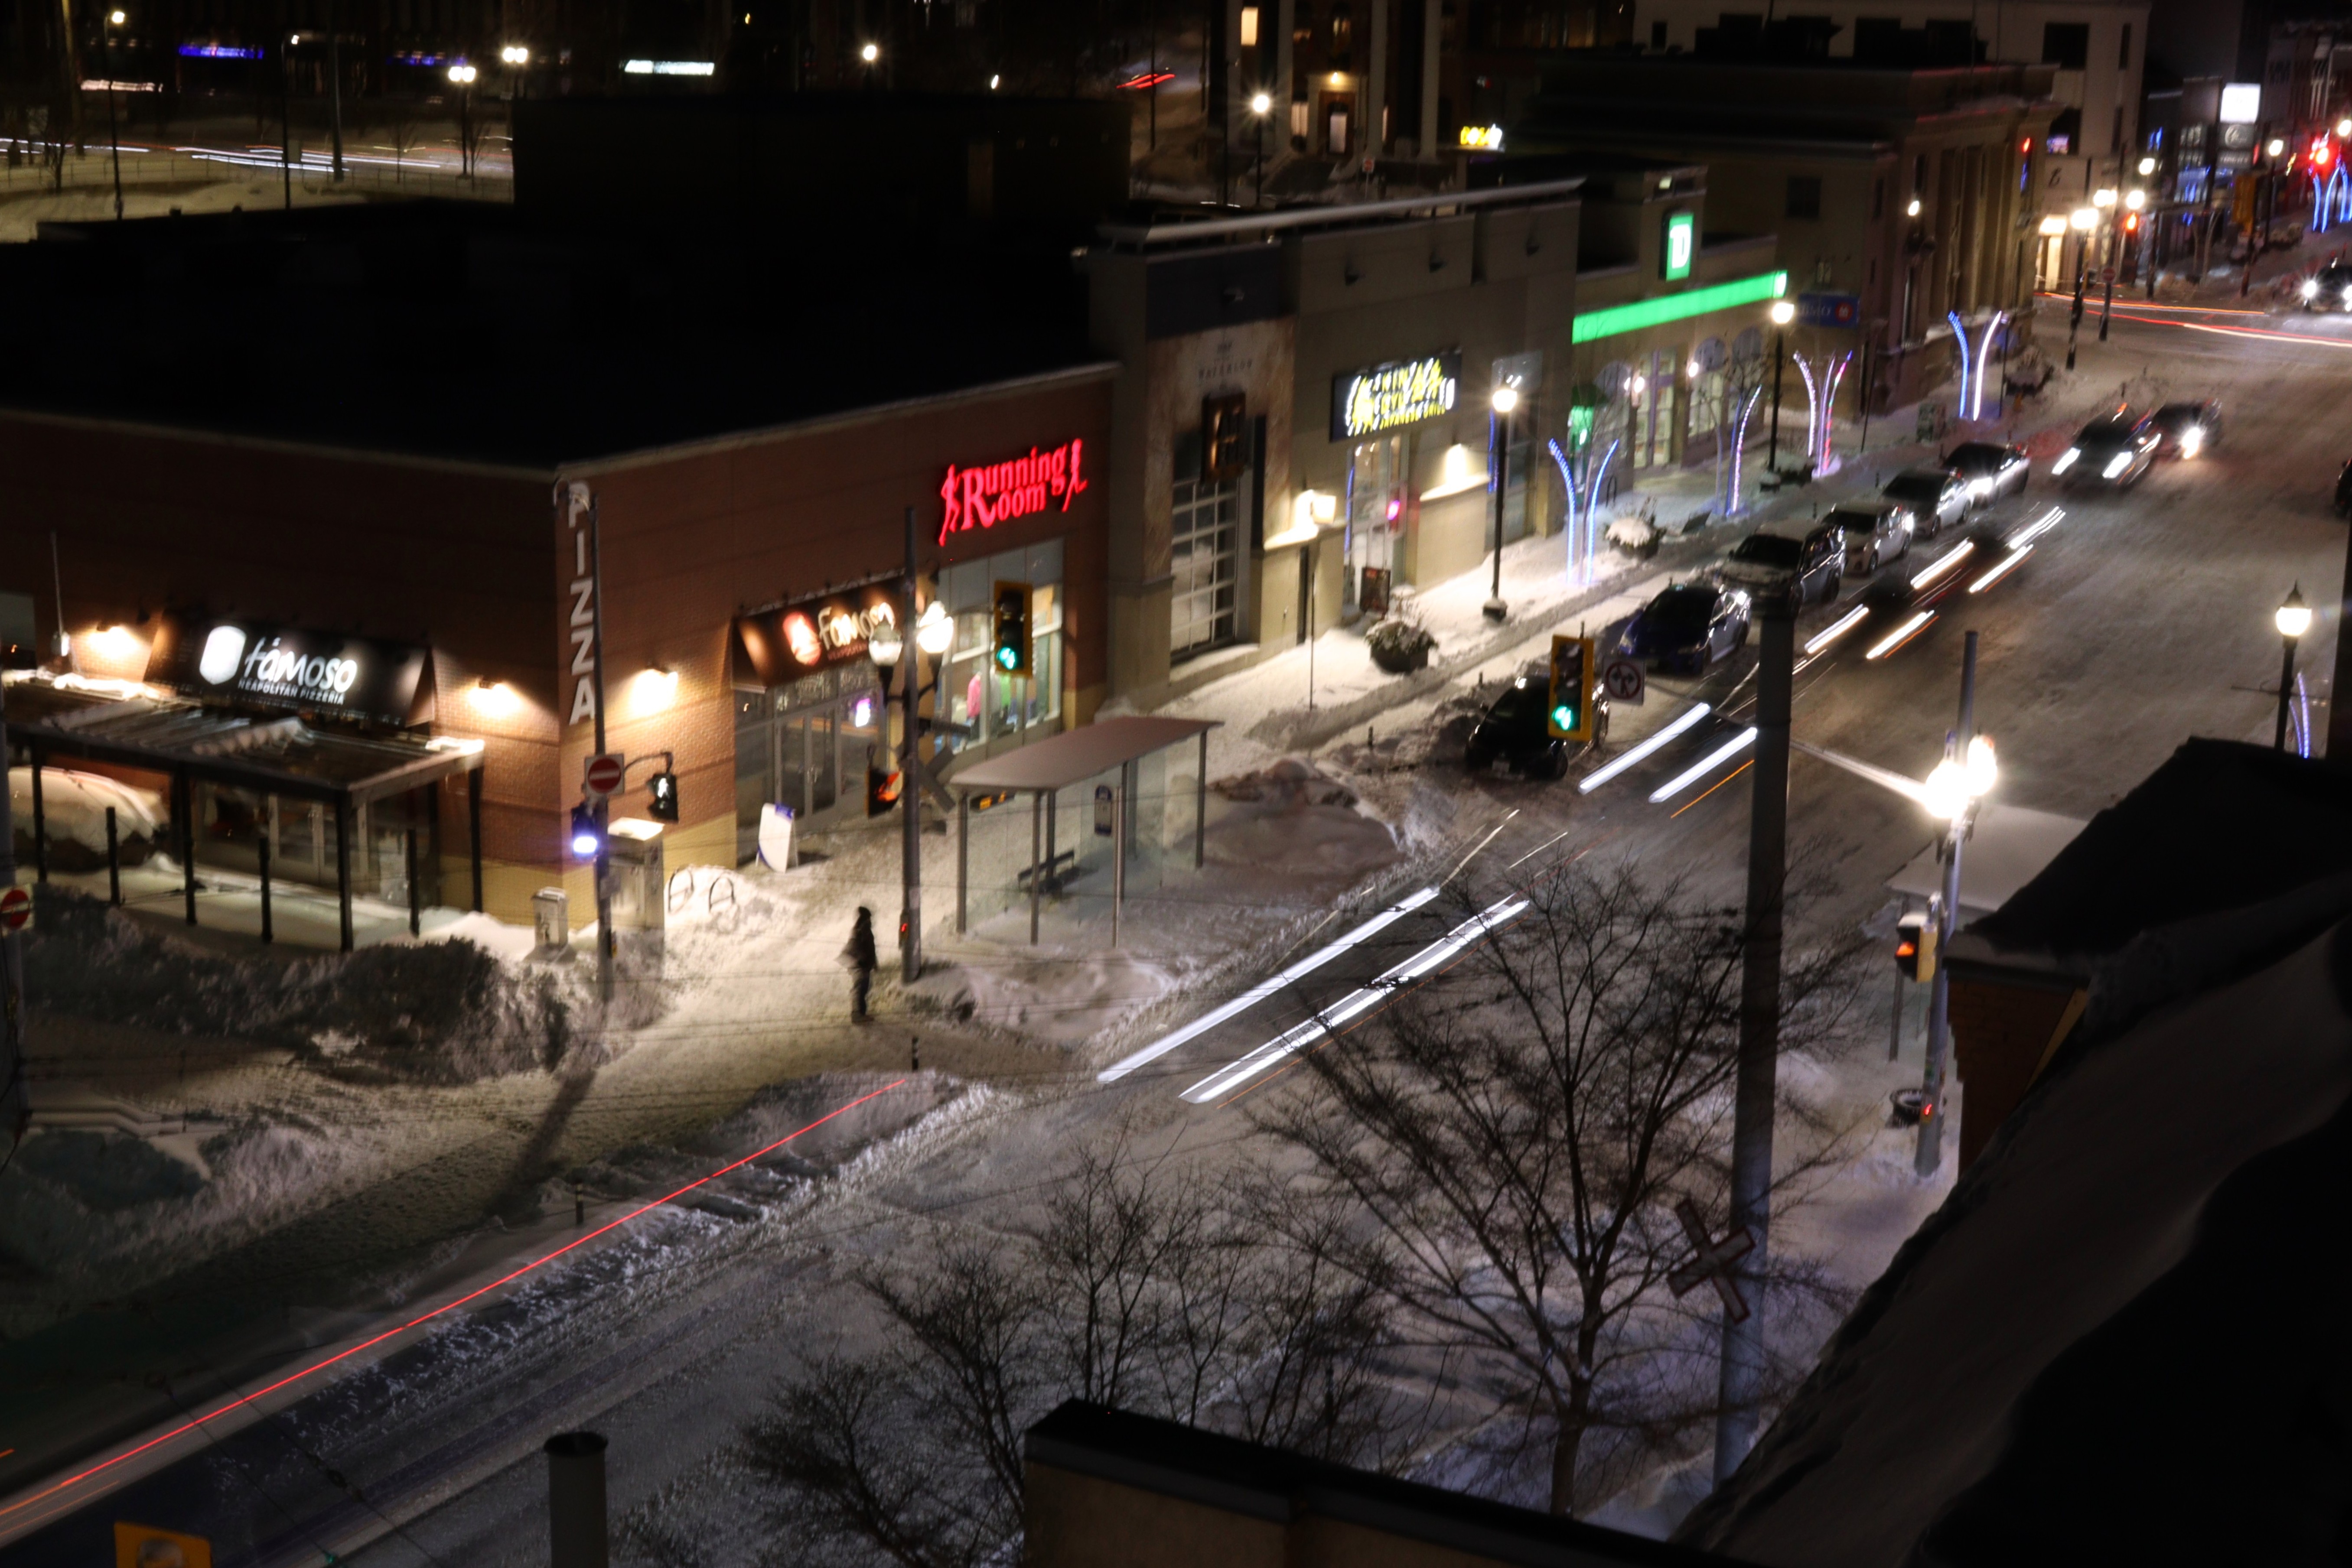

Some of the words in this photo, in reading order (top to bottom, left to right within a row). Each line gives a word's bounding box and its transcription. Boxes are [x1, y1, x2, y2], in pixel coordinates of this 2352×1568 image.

[961, 443, 1067, 530] Running
[568, 480, 596, 726] PIZZA
[238, 677, 298, 697] NEAPOLITAN
[300, 686, 345, 706] PIZZERIA
